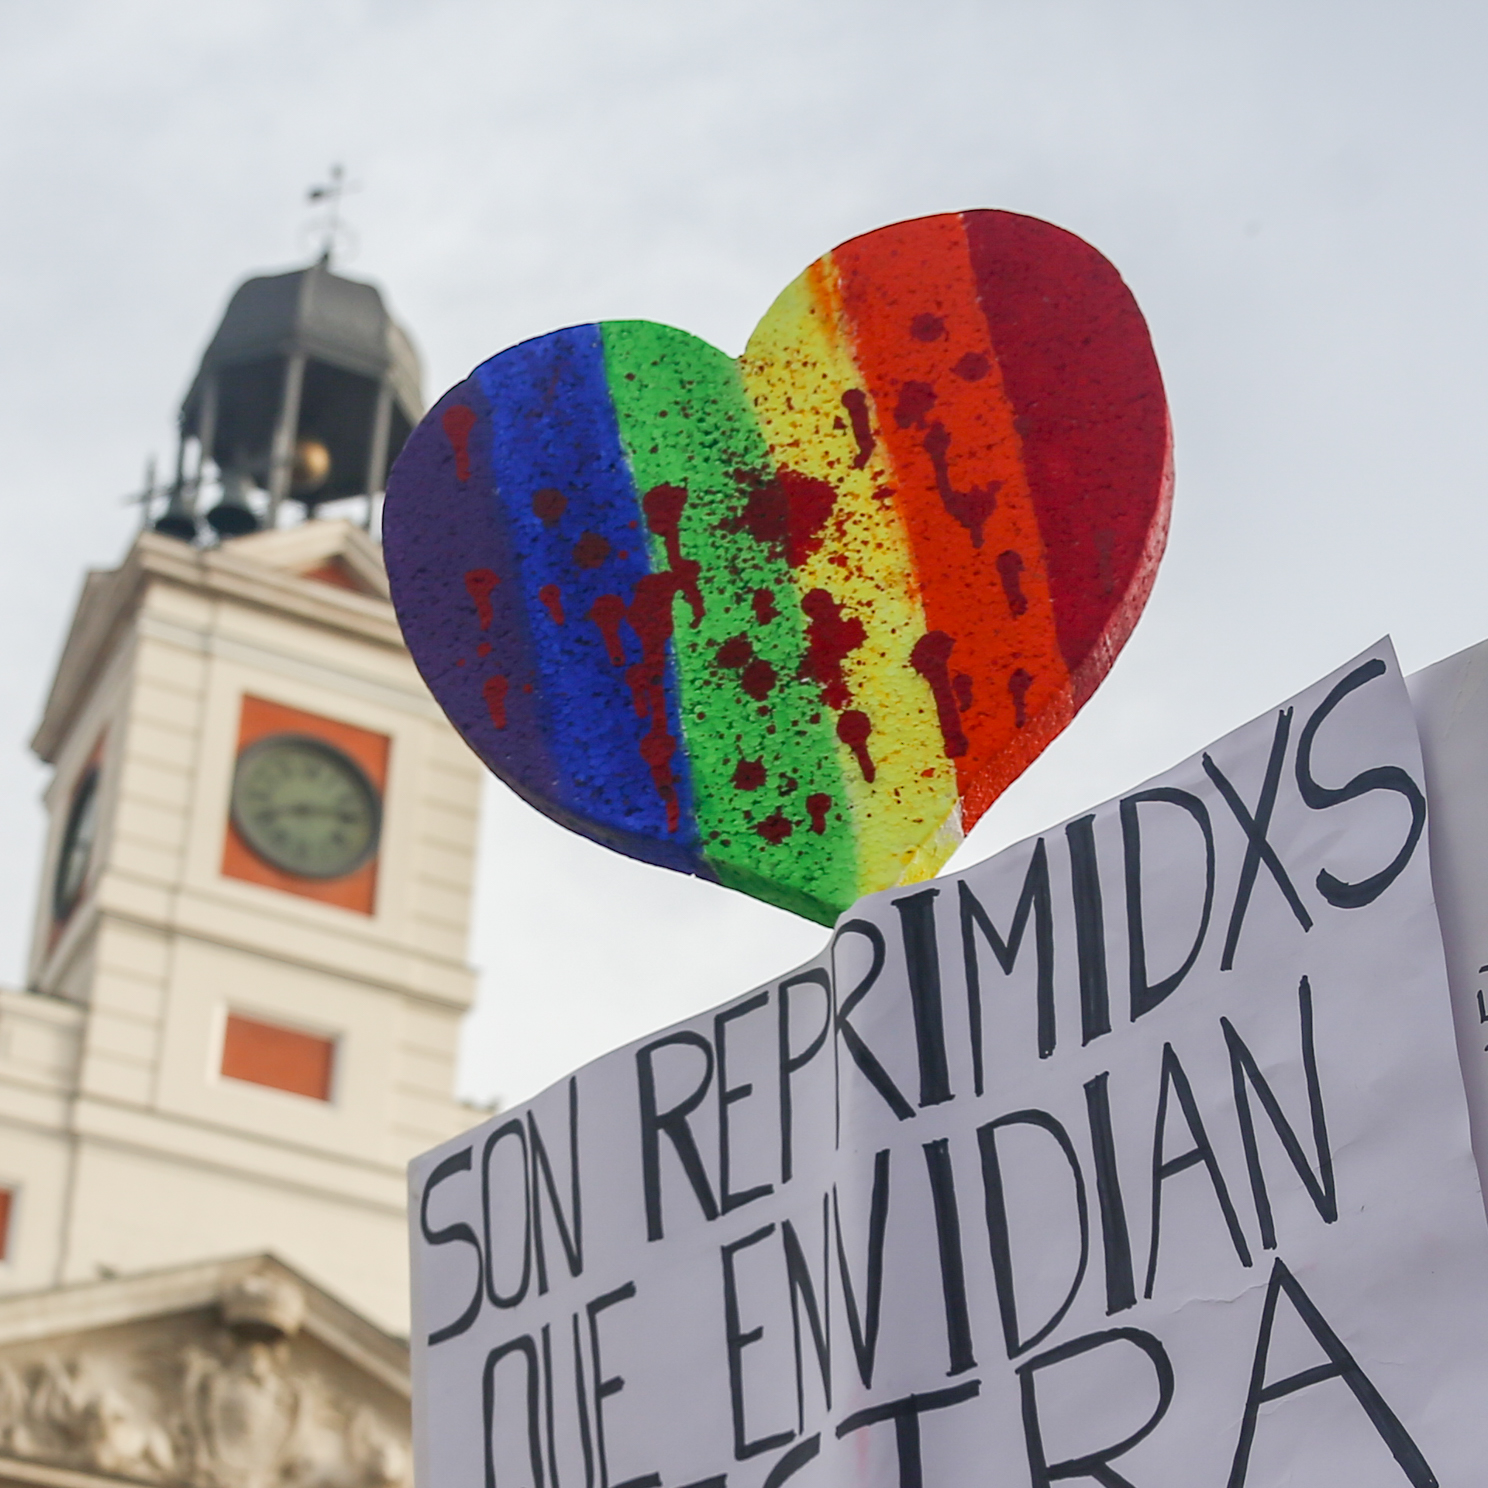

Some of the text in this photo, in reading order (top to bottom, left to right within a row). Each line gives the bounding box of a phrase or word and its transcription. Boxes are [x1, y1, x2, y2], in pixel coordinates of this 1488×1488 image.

[416, 657, 1429, 1345] SON REPRIMIDXS
[722, 973, 1341, 1465] ENVIDIAN
